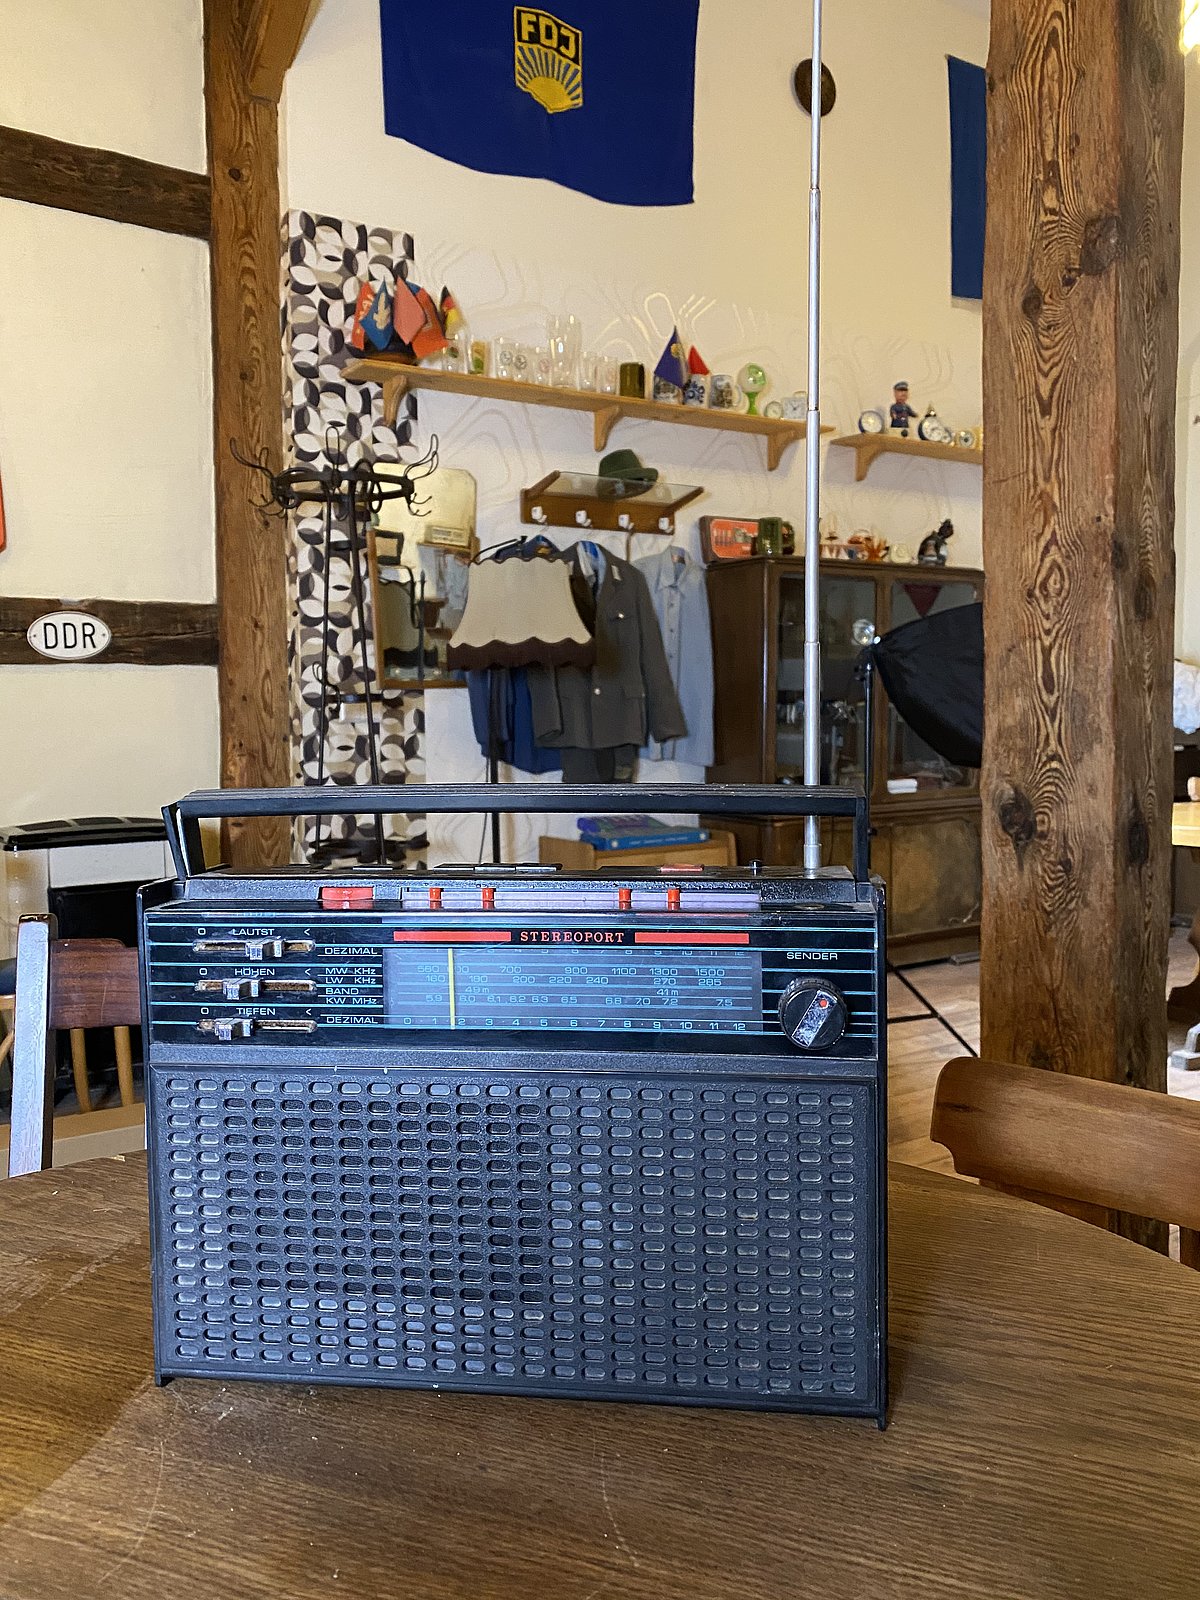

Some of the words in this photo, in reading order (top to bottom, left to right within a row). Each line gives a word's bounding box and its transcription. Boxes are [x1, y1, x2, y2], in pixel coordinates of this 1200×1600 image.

[520, 12, 576, 59] FDJ
[43, 622, 96, 649] DDR
[232, 928, 275, 936] LAUTST
[520, 931, 624, 943] STEREOPORT
[324, 947, 378, 955] DEZIMAL
[786, 952, 838, 960] SENDER
[500, 966, 522, 974] 700
[649, 968, 678, 976] 1300
[695, 968, 725, 976] 1500
[549, 976, 572, 984] 220
[236, 1007, 275, 1015] TIEFEN
[326, 1016, 378, 1024] DEZIMAL
[458, 1018, 466, 1026] 2
[485, 1018, 493, 1026] 3
[570, 1019, 578, 1027] 6
[653, 1021, 661, 1029] 9
[709, 1022, 719, 1030] 11
[733, 1023, 746, 1031] 12
